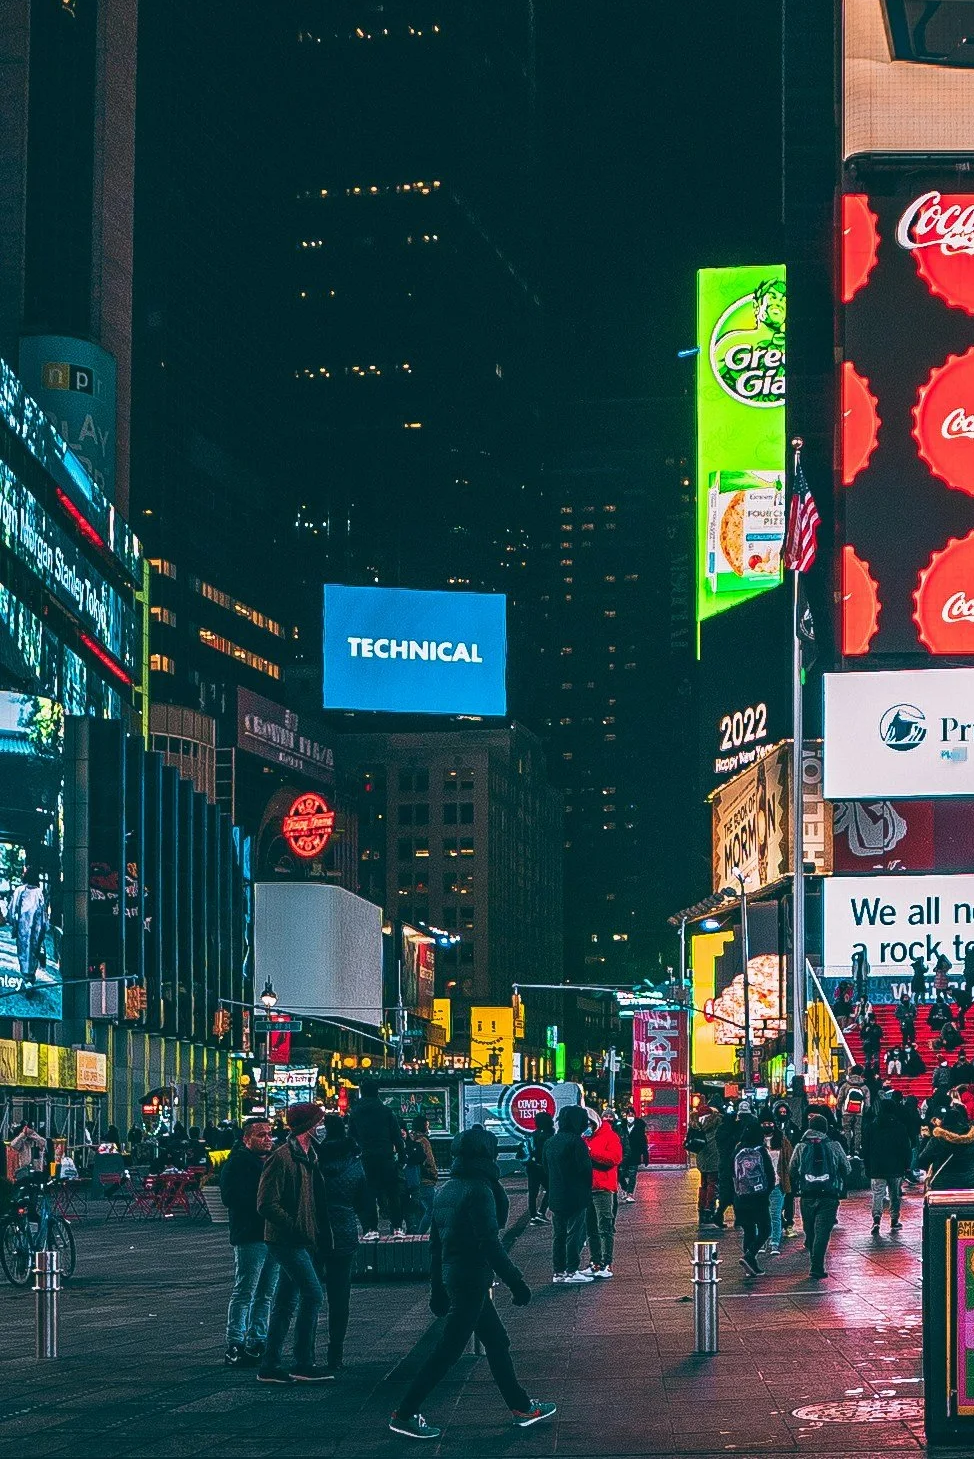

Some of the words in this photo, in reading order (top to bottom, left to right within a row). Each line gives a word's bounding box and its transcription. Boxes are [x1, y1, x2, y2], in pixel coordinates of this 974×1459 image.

[20, 507, 53, 574] Morgan
[54, 546, 85, 611] Stanley
[84, 578, 108, 627] Tokyo
[347, 637, 483, 663] TECHNICAL
[719, 702, 767, 752] 2022
[715, 755, 739, 774] Happy
[739, 749, 756, 766] New
[298, 797, 319, 814] HOT
[723, 818, 733, 840] THE
[733, 806, 748, 832] BOOK
[749, 791, 757, 817] OF
[724, 791, 778, 881] MORMON
[851, 898, 897, 927] We
[908, 897, 941, 925] all
[880, 934, 942, 963] rock
[647, 1016, 679, 1082] tkts
[518, 1099, 548, 1109] COVID-19
[519, 1108, 546, 1119] TEST
